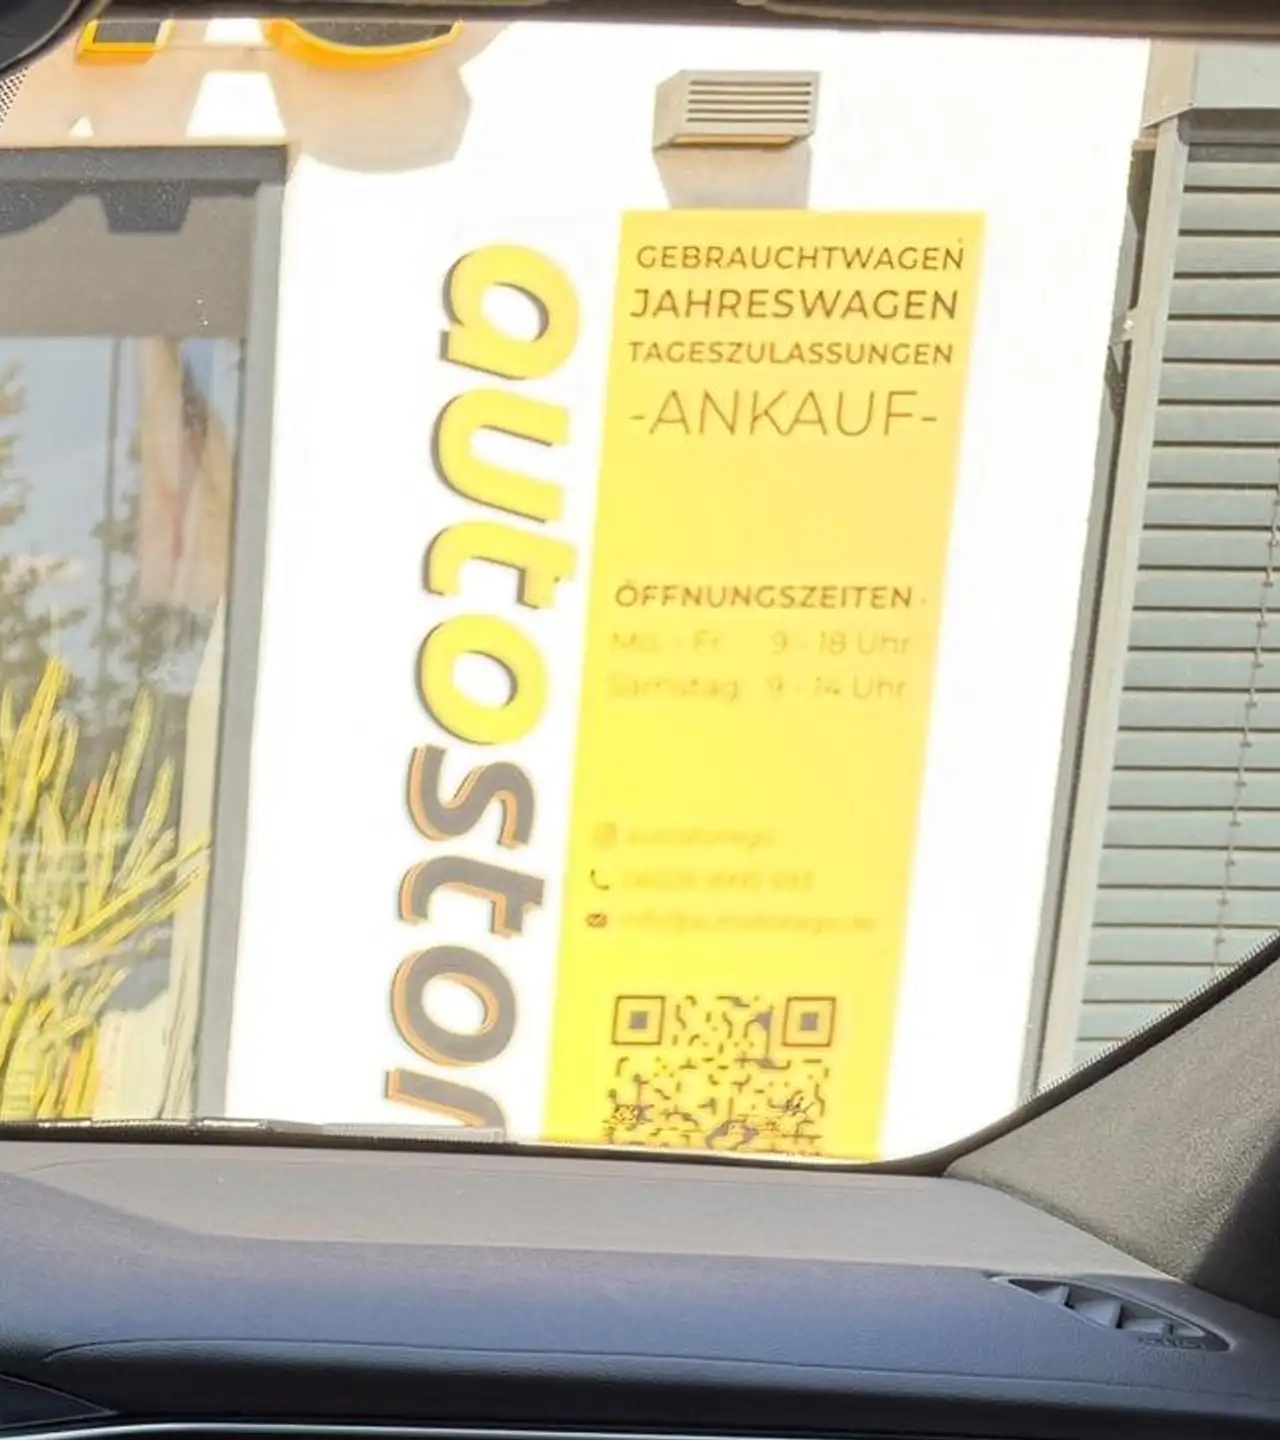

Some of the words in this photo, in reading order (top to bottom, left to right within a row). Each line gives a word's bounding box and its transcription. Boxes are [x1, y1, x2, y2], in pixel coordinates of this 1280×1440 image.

[636, 245, 964, 270] GEBRAUCHTWAGEN
[629, 288, 958, 320] JAHRESWAGEN
[628, 340, 954, 365] TAGESZULASSUNGEN
[630, 389, 938, 437] -ANKAUF-
[614, 579, 913, 609] ÖFFNUNGSZEITEN
[856, 630, 910, 655] Uhr
[852, 674, 907, 699] Uhr
